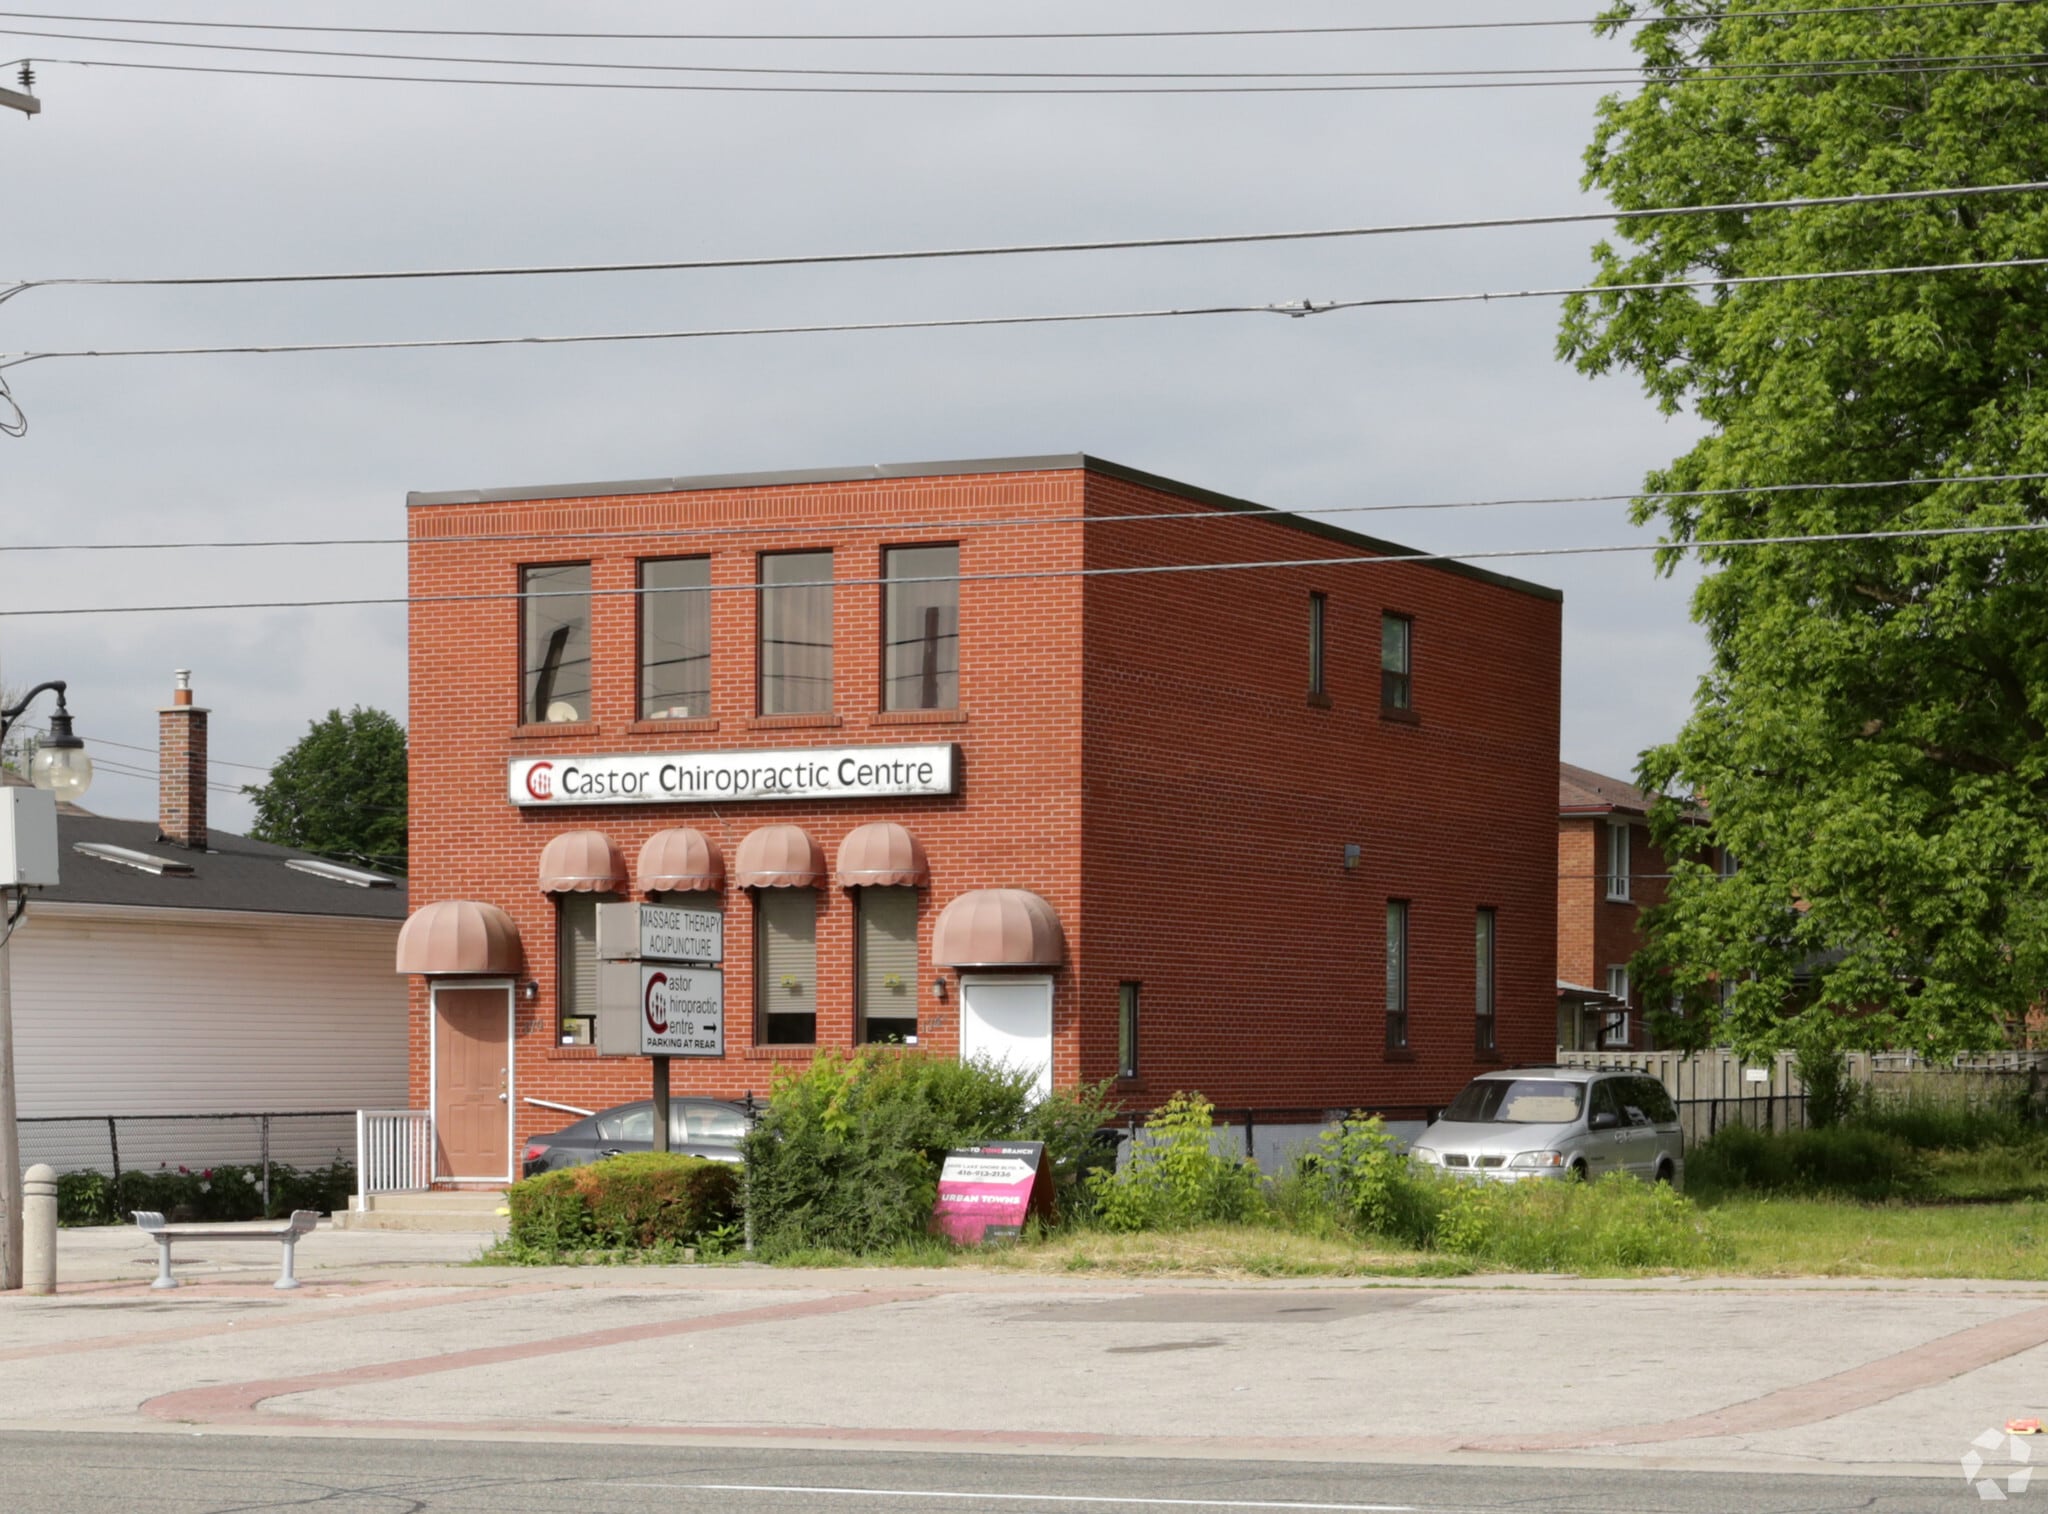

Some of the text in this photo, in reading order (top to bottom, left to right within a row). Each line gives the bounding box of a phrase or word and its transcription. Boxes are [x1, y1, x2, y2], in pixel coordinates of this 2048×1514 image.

[562, 758, 933, 795] Castor Chiropractic Centre
[641, 909, 721, 934] MASSAGE THERAPY
[649, 935, 712, 956] ACUPUNCTURE
[647, 1038, 716, 1049] PARKING AT REAR
[942, 1194, 1020, 1204] URBAN TOWNS
